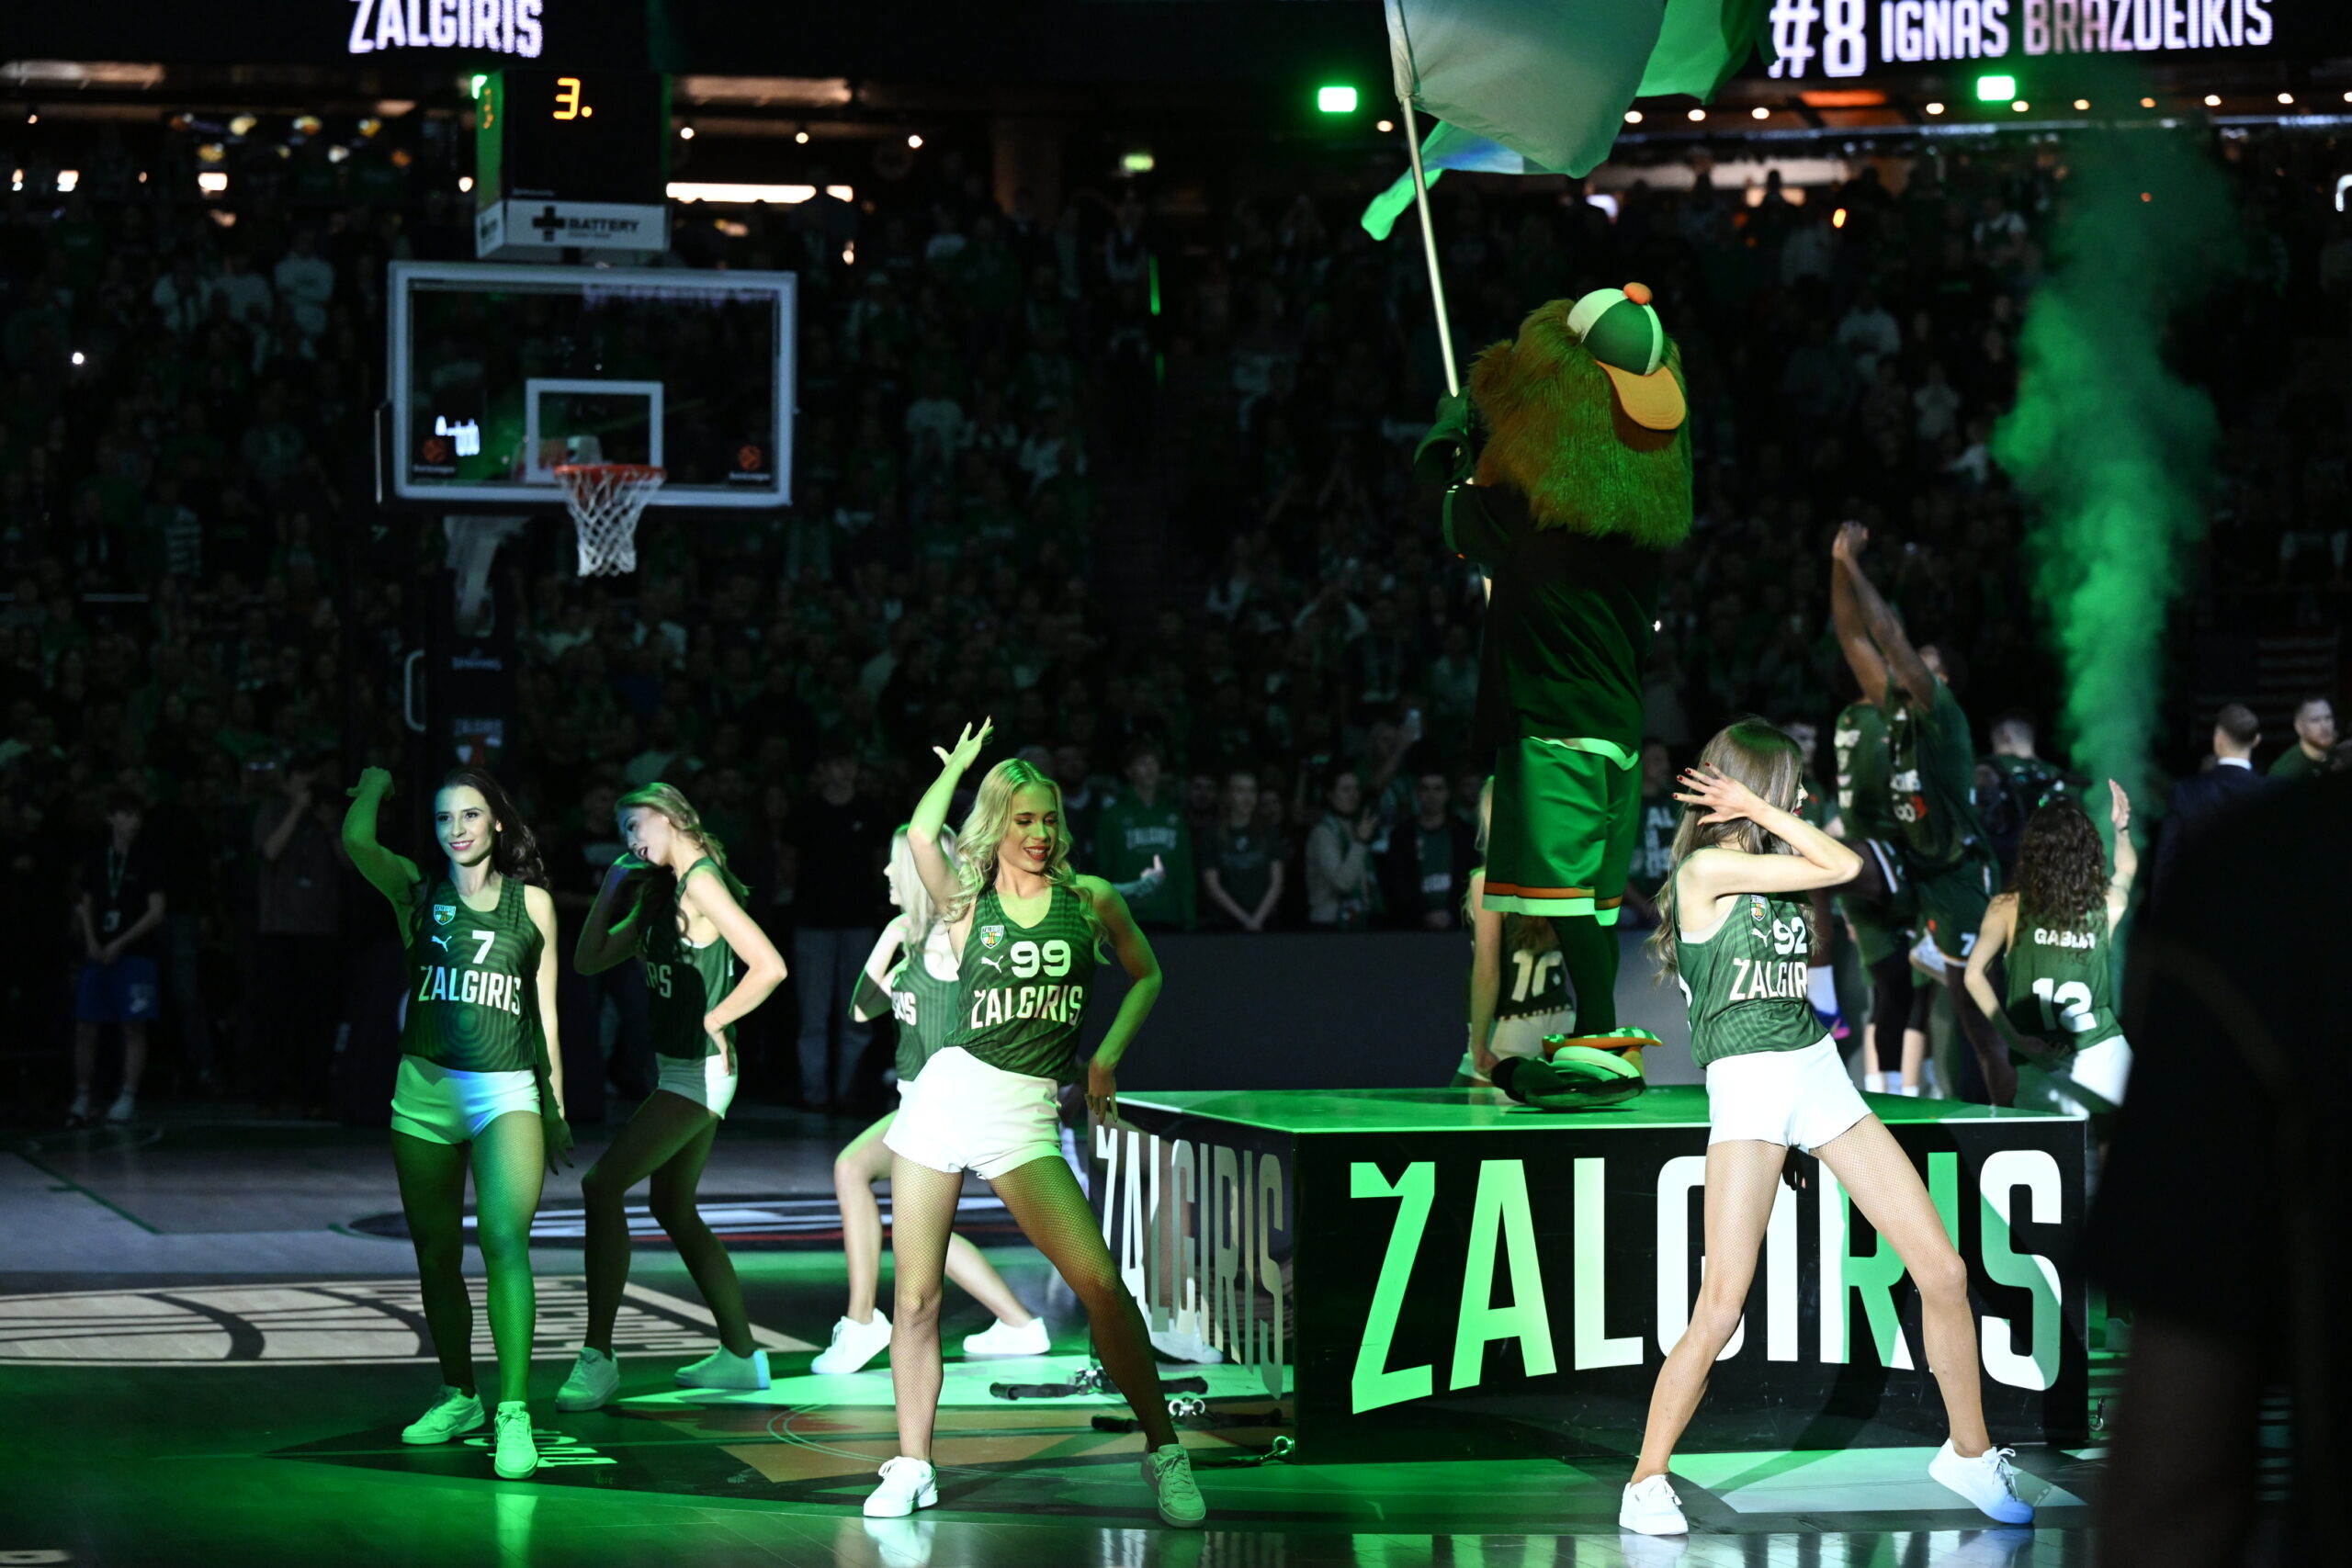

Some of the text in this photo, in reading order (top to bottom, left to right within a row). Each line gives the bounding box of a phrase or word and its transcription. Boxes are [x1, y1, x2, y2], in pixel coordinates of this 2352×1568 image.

[1881, 0, 2010, 62] IGNAS
[569, 218, 639, 232] BATTERY
[472, 930, 495, 964] 7
[1772, 917, 1808, 955] 92
[1010, 939, 1072, 978] 99
[2032, 977, 2098, 1033] 12
